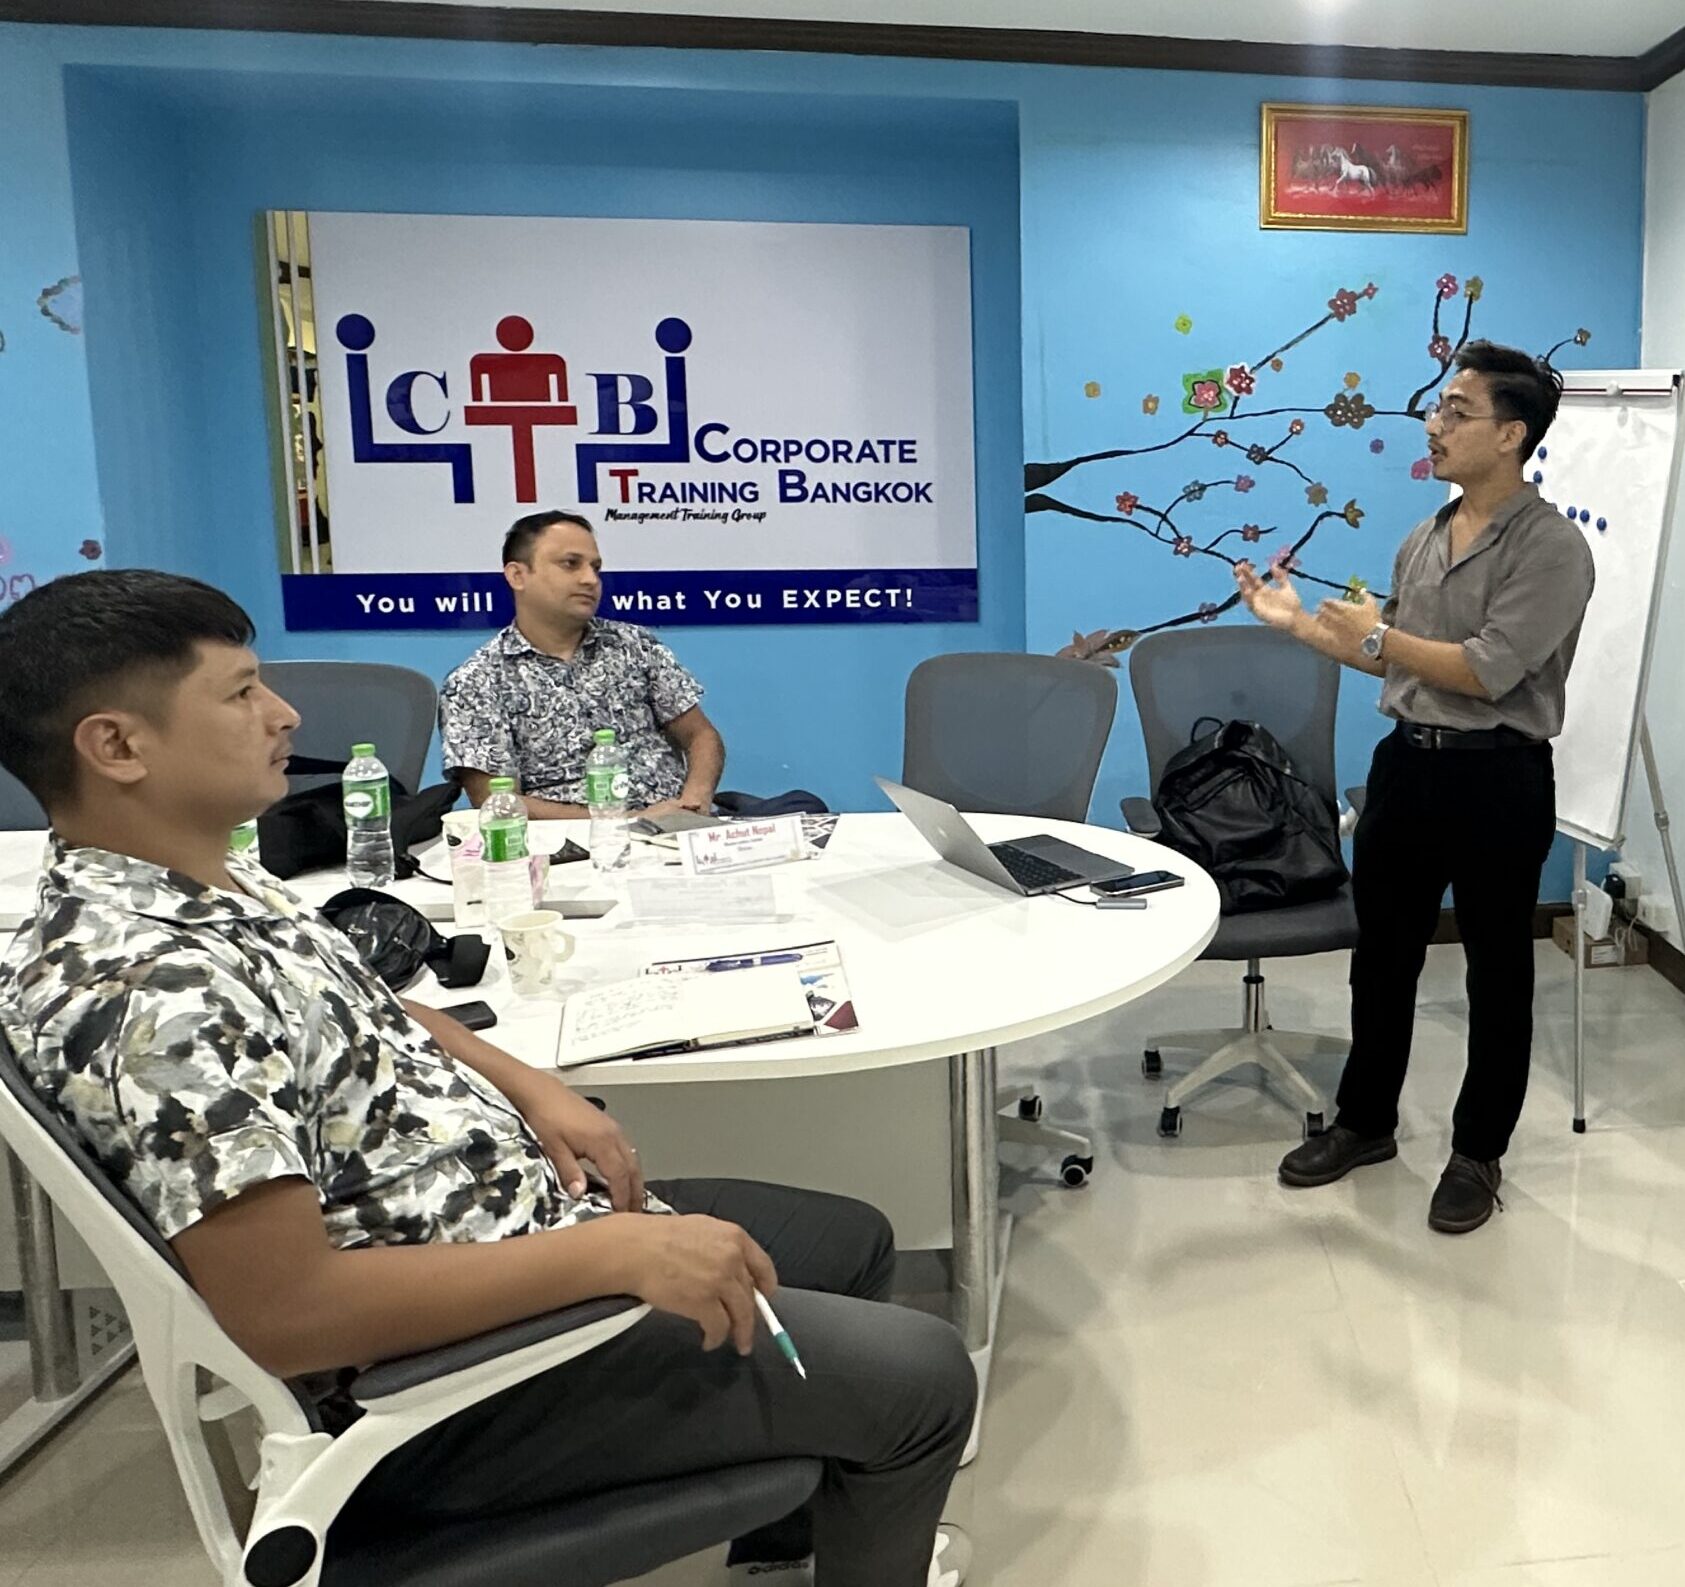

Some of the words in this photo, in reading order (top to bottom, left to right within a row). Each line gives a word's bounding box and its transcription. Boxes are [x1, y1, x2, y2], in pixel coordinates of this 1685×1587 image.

[694, 422, 918, 464] CORPORATE
[608, 468, 760, 504] TRAINING
[777, 468, 934, 504] BANGKOK
[605, 507, 681, 525] Management
[680, 507, 728, 524] Training
[731, 508, 767, 524] Group
[355, 593, 415, 614] You
[434, 591, 494, 613] will
[611, 590, 687, 611] what
[703, 590, 763, 610] You
[782, 588, 914, 609] EXPECT!
